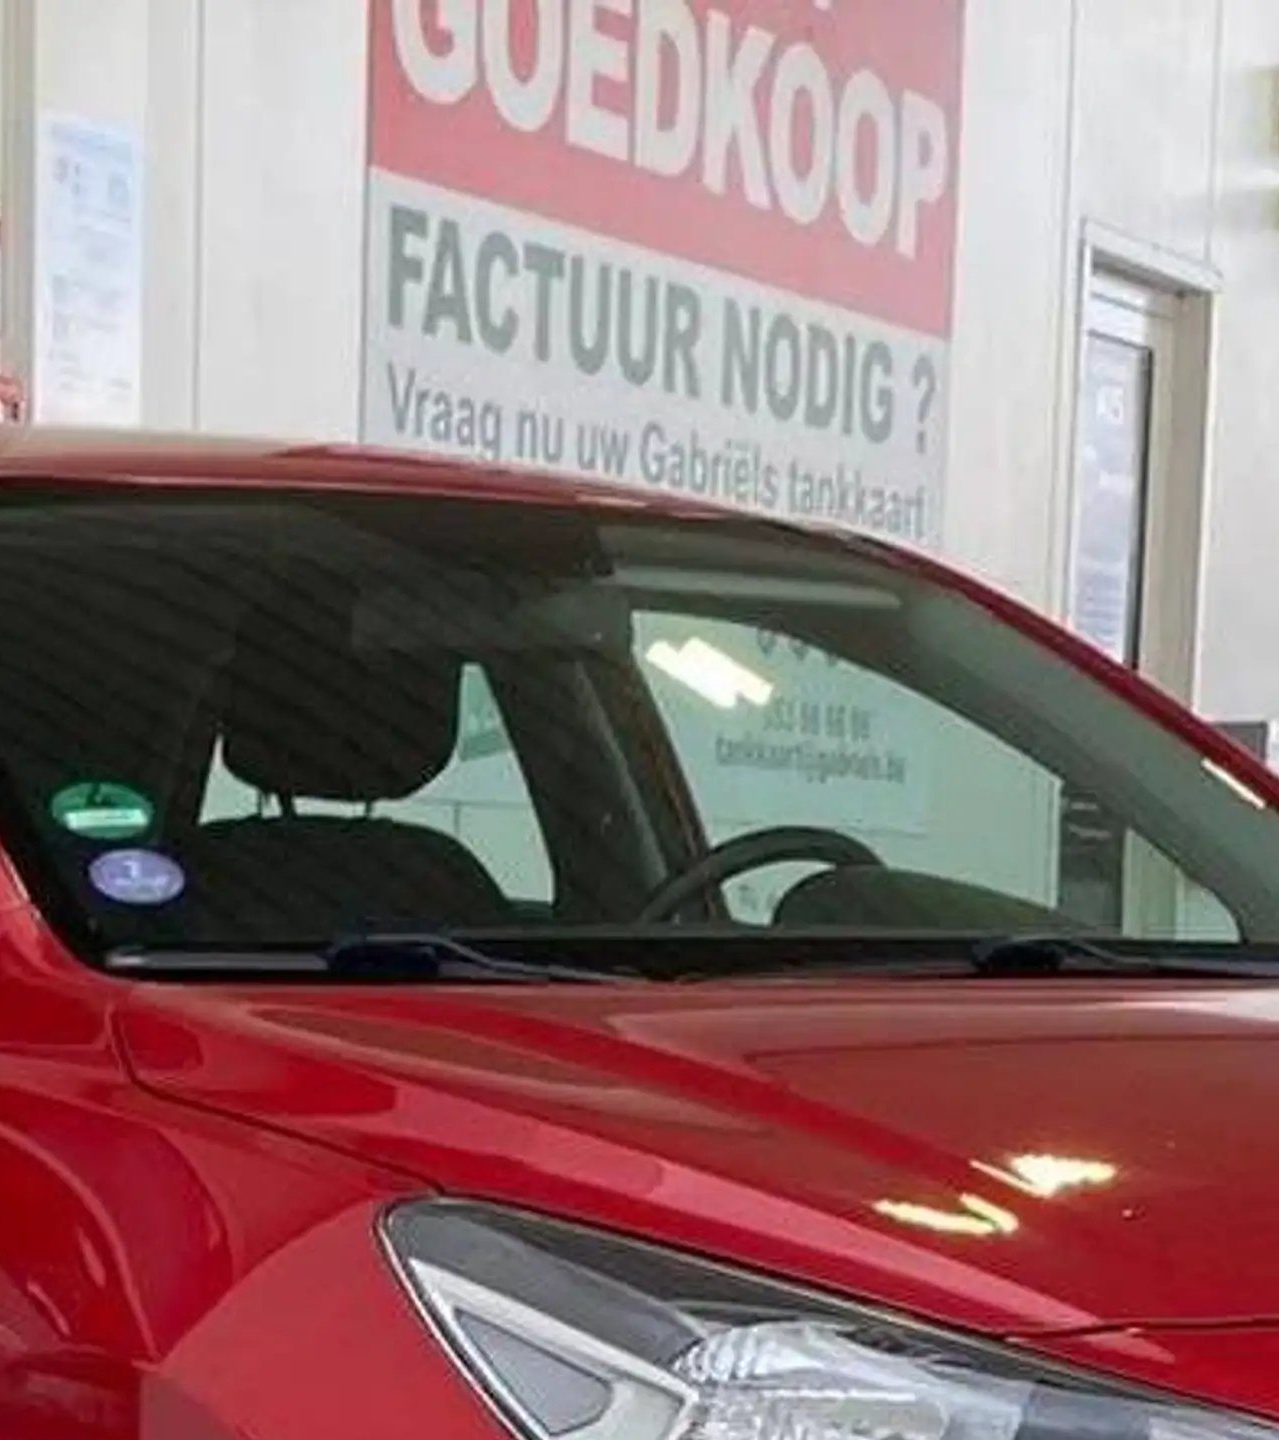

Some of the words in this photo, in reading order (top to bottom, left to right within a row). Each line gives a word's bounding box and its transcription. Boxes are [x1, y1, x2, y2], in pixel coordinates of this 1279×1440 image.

[392, 0, 948, 260] GOEDKOOP
[386, 204, 701, 399] FACTUUR
[720, 297, 894, 444] NODIG
[912, 353, 937, 455] ?
[386, 360, 503, 460] Vraag
[515, 406, 564, 463] nu
[576, 424, 625, 477] uw
[638, 421, 779, 506] Gabriëls
